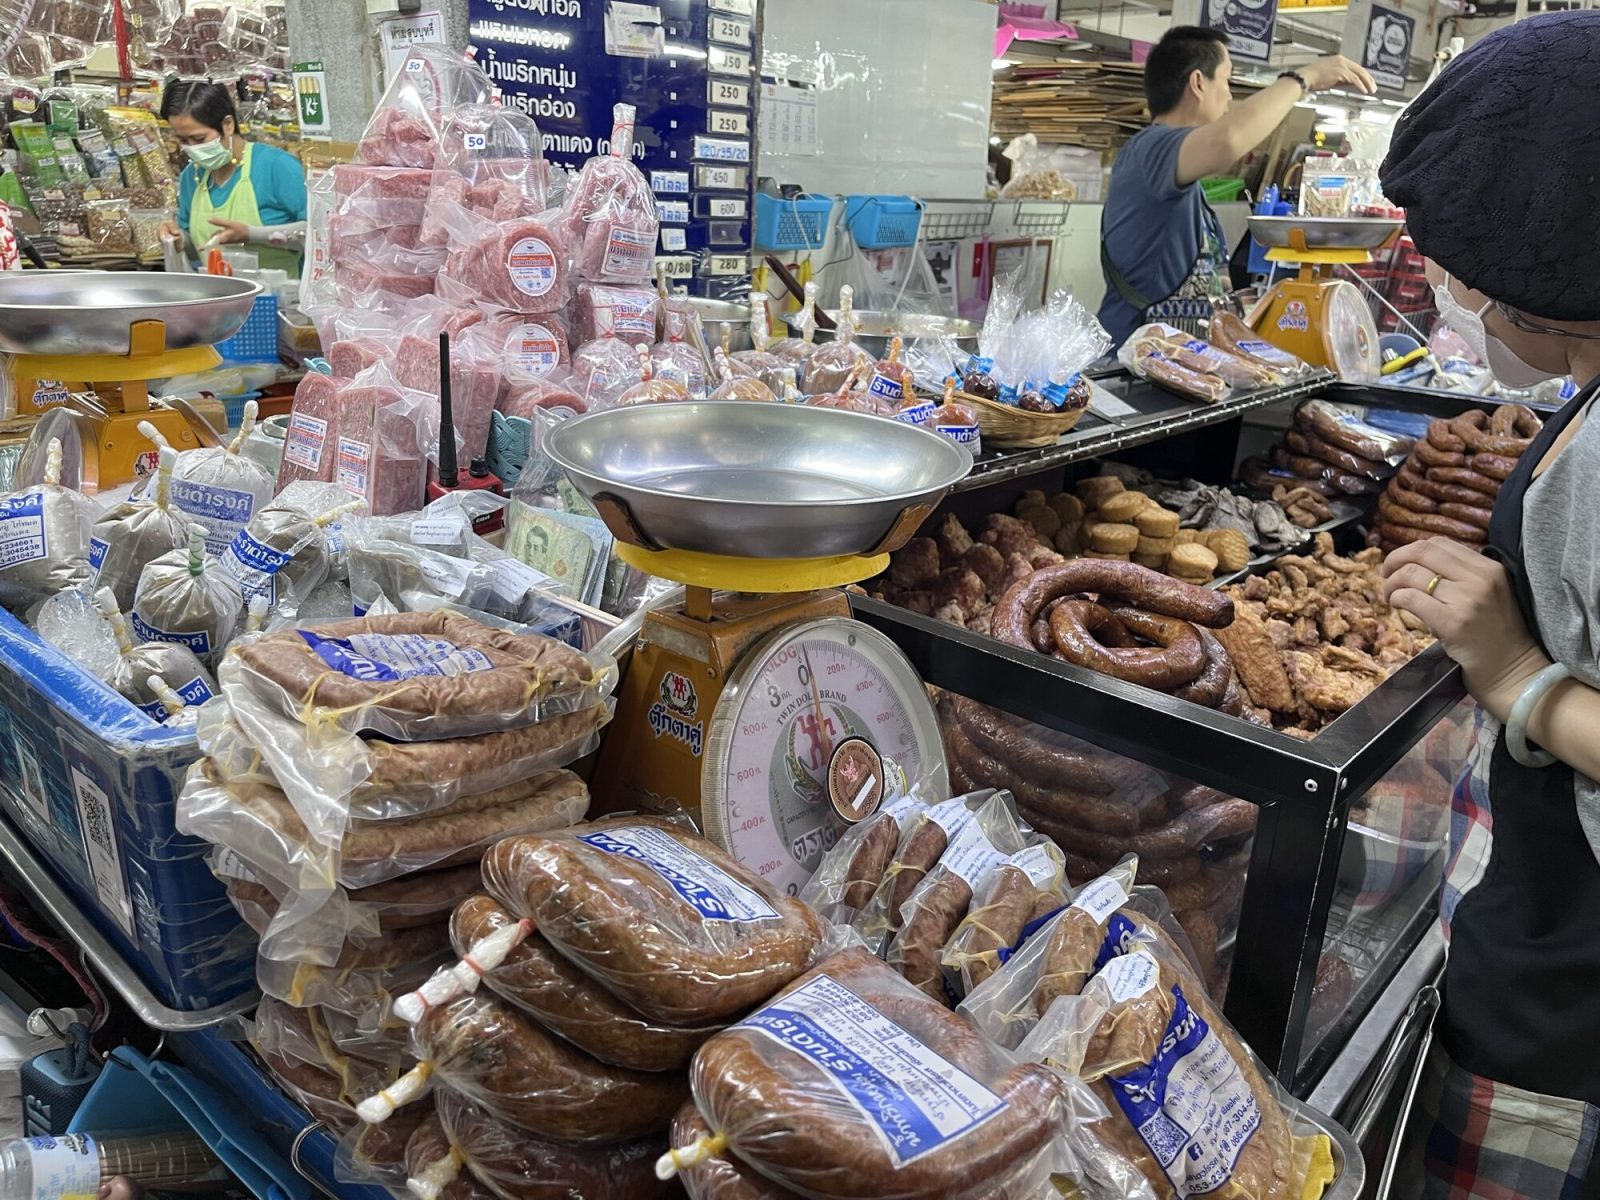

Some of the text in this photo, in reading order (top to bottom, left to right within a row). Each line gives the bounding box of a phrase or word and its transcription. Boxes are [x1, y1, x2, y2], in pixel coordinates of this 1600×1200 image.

[722, 23, 740, 37] 250
[408, 60, 420, 70] 50
[482, 48, 576, 94] น้ำพริกหนุ่ม
[720, 86, 739, 99] 250
[719, 118, 737, 130] 250
[468, 136, 484, 147] 50
[712, 172, 728, 183] 450
[720, 203, 736, 215] 600
[719, 258, 738, 270] 280
[776, 689, 847, 726] TWIN DOL BRAND
[649, 703, 702, 754] ตุ๊กตาคู่
[861, 791, 877, 815] 2566
